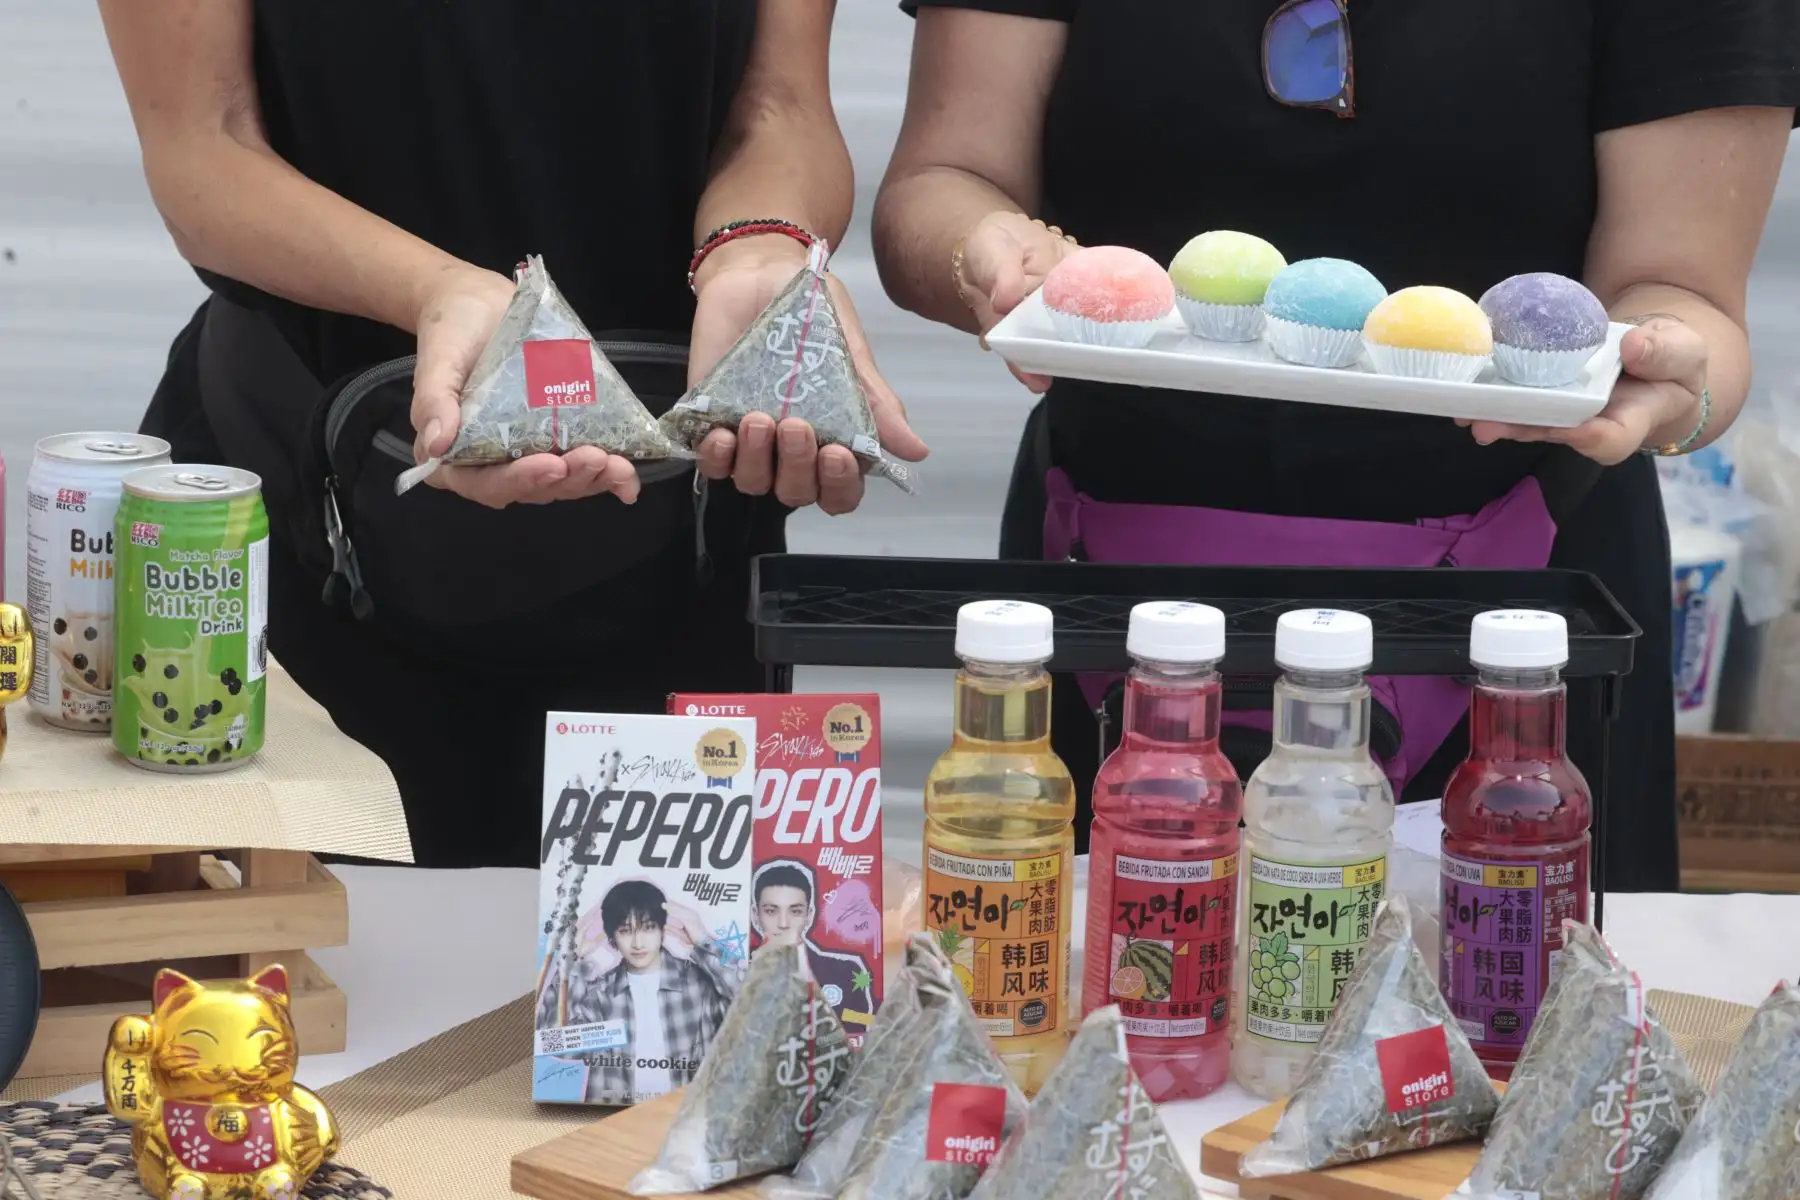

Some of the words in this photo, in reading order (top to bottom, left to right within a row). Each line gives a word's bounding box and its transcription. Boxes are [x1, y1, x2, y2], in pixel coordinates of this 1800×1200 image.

[544, 380, 590, 395] onigiri
[547, 394, 591, 405] store
[56, 502, 86, 513] RICO
[131, 536, 159, 547] RICO
[171, 550, 209, 561] Matcha
[213, 549, 243, 560] Flavor
[146, 564, 241, 589] Bubble
[201, 618, 242, 634] Drink
[701, 705, 745, 715] LOTTE
[571, 725, 617, 734] LOTTE
[830, 716, 864, 733] No.1
[703, 741, 738, 758] No.1
[711, 759, 738, 767] Korea
[752, 768, 882, 844] PERO
[542, 788, 753, 870] PEPERO
[817, 846, 874, 880] 빼빼로
[930, 852, 945, 867] BEBIDA
[946, 860, 975, 875] FRUTADA
[976, 865, 993, 877] CON
[994, 862, 1012, 877] PIÑA
[1119, 861, 1139, 875] BEBIDA
[1141, 865, 1171, 879] FRUTADA
[1172, 867, 1186, 879] CON
[1468, 868, 1480, 880] UVA
[1545, 874, 1574, 885] BAOLISU
[682, 873, 742, 907] 빼빼로
[1029, 882, 1043, 935] 大果肉
[1498, 890, 1514, 944] 大果肉
[1001, 940, 1049, 969] 韩国
[1473, 947, 1524, 976] 韩国
[1001, 968, 1048, 996] 风味
[1473, 976, 1524, 1004] 风味
[583, 1054, 632, 1068] white
[636, 1056, 698, 1070] cookie
[1402, 1071, 1448, 1095] onigiri
[1404, 1087, 1449, 1107] store
[944, 1135, 996, 1152] onigiri
